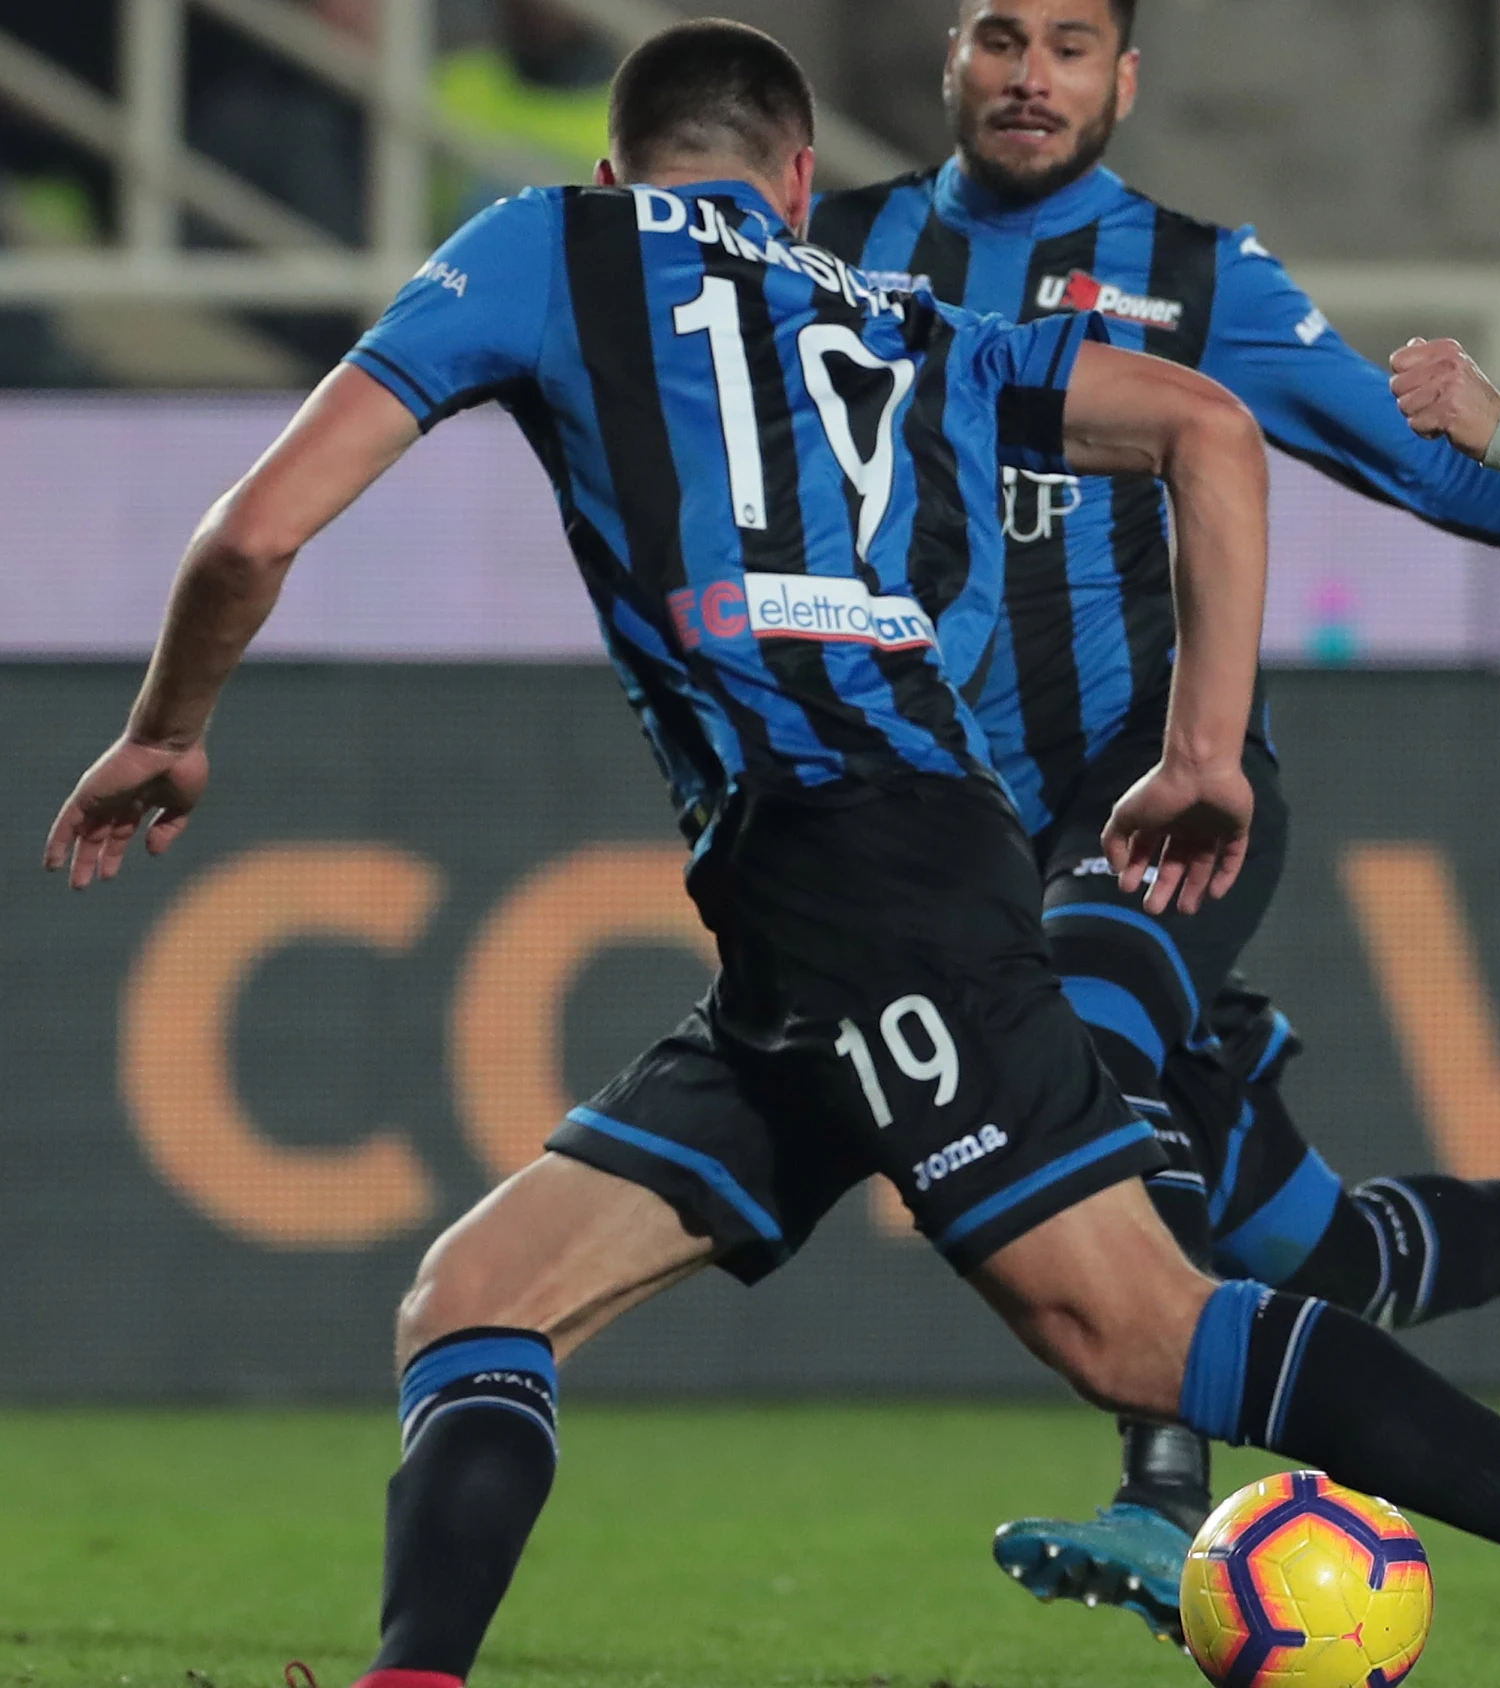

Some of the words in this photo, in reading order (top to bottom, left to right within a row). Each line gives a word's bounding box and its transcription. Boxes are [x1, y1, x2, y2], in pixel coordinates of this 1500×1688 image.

[673, 275, 916, 564] 19
[834, 994, 959, 1129] 19
[912, 1123, 1009, 1192] Joma
